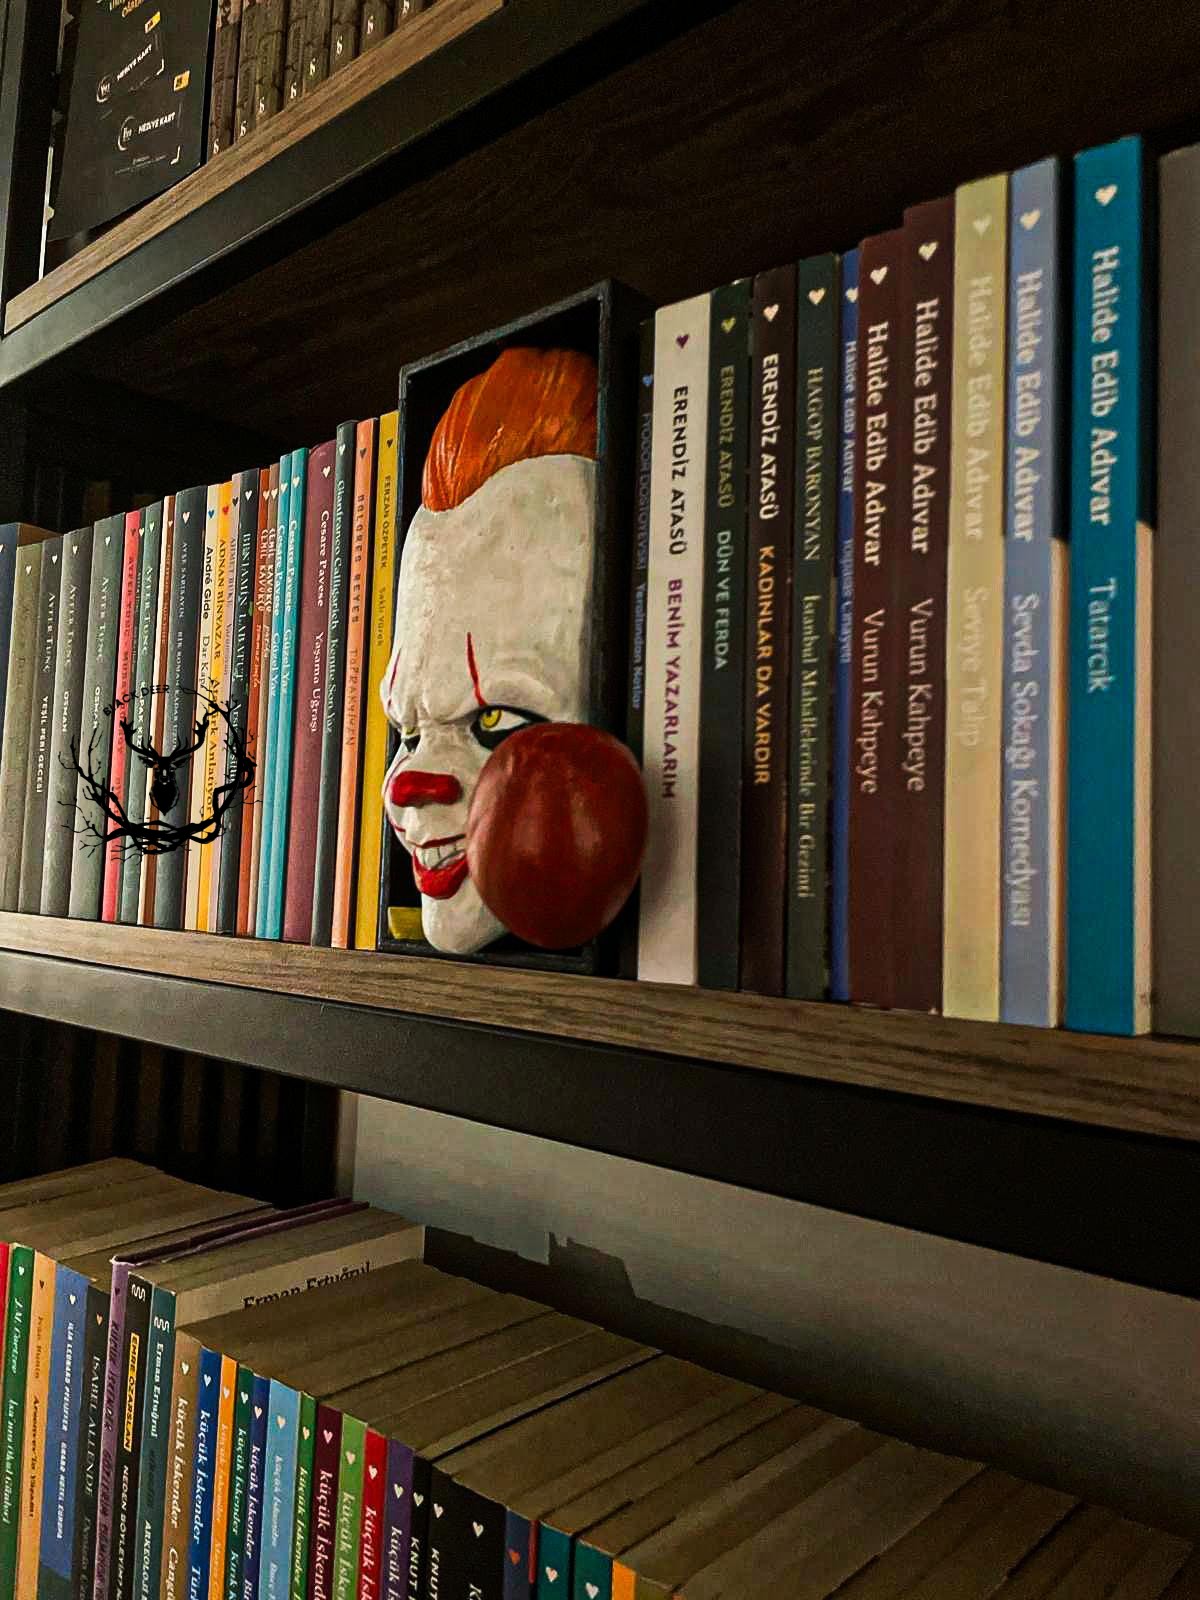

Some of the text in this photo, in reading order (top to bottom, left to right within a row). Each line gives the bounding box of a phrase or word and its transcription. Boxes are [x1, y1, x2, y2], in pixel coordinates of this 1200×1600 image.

[966, 277, 989, 366] Halide
[966, 377, 989, 439] Edib
[382, 475, 392, 517] FERZAN
[965, 447, 988, 542] Adıvar
[1088, 245, 1119, 693] Halide Edib Adıvar Tatarcık
[276, 525, 285, 568] Cesare
[288, 520, 297, 563] Cesare
[318, 511, 330, 556] Cesare
[334, 480, 345, 555] Gianfranco
[379, 522, 391, 568] ÖZPETEK
[713, 366, 736, 670] ERENDİZ ATASÜ DÜN VE FERDA
[904, 300, 938, 790] Halide Edib Adıvar Vurun Kahpeye
[217, 539, 226, 586] ADNAN
[316, 560, 329, 607] Pavese
[351, 495, 365, 623] DOLORES REYES
[752, 354, 782, 783] ERENDİZ ATASÜ KADINLAR DA VARDIR
[856, 322, 888, 793] Halide Edib Adıvar Vurun Kahpeye
[46, 593, 56, 632] AYFER
[68, 584, 77, 624] AYFER
[100, 577, 109, 618] AYFER
[201, 547, 213, 659] André Gide Dar
[273, 572, 283, 615] Pavese
[286, 567, 296, 612] Pavese
[329, 557, 343, 630] Calligarich
[661, 387, 689, 798] ERENDİZ ATASÜ BENİM YAZARLARIM
[1004, 272, 1042, 927] Halide Edib Adıvar Sevda Sokağı Komedyası
[213, 591, 226, 659] BİNYAZAR
[796, 368, 823, 897] HAGOP BARONYAN İstanbul Mahallelerinde Bir Gezinti
[93, 687, 101, 729] OSMAN
[310, 688, 321, 732] Uğrası
[130, 1336, 138, 1373] EMRE
[154, 1342, 164, 1382] Erman
[85, 1355, 101, 1496] ISABEL ALLENDE
[149, 1385, 162, 1437] Ertuğrul
[174, 1397, 188, 1452] küçük
[193, 1410, 211, 1544] küçük İskender
[234, 1428, 246, 1471] küçük
[121, 1465, 129, 1511] NEDEN
[171, 1455, 185, 1528] İskender
[231, 1475, 243, 1535] İskender
[245, 1445, 261, 1559] küçük İskender
[296, 1467, 308, 1514] küçük
[317, 1470, 332, 1531] küçük
[294, 1520, 307, 1585] İskender
[339, 1492, 355, 1553] küçük
[362, 1506, 377, 1569] küçük
[387, 1527, 402, 1583] küçük
[408, 1537, 420, 1591] KNUT
